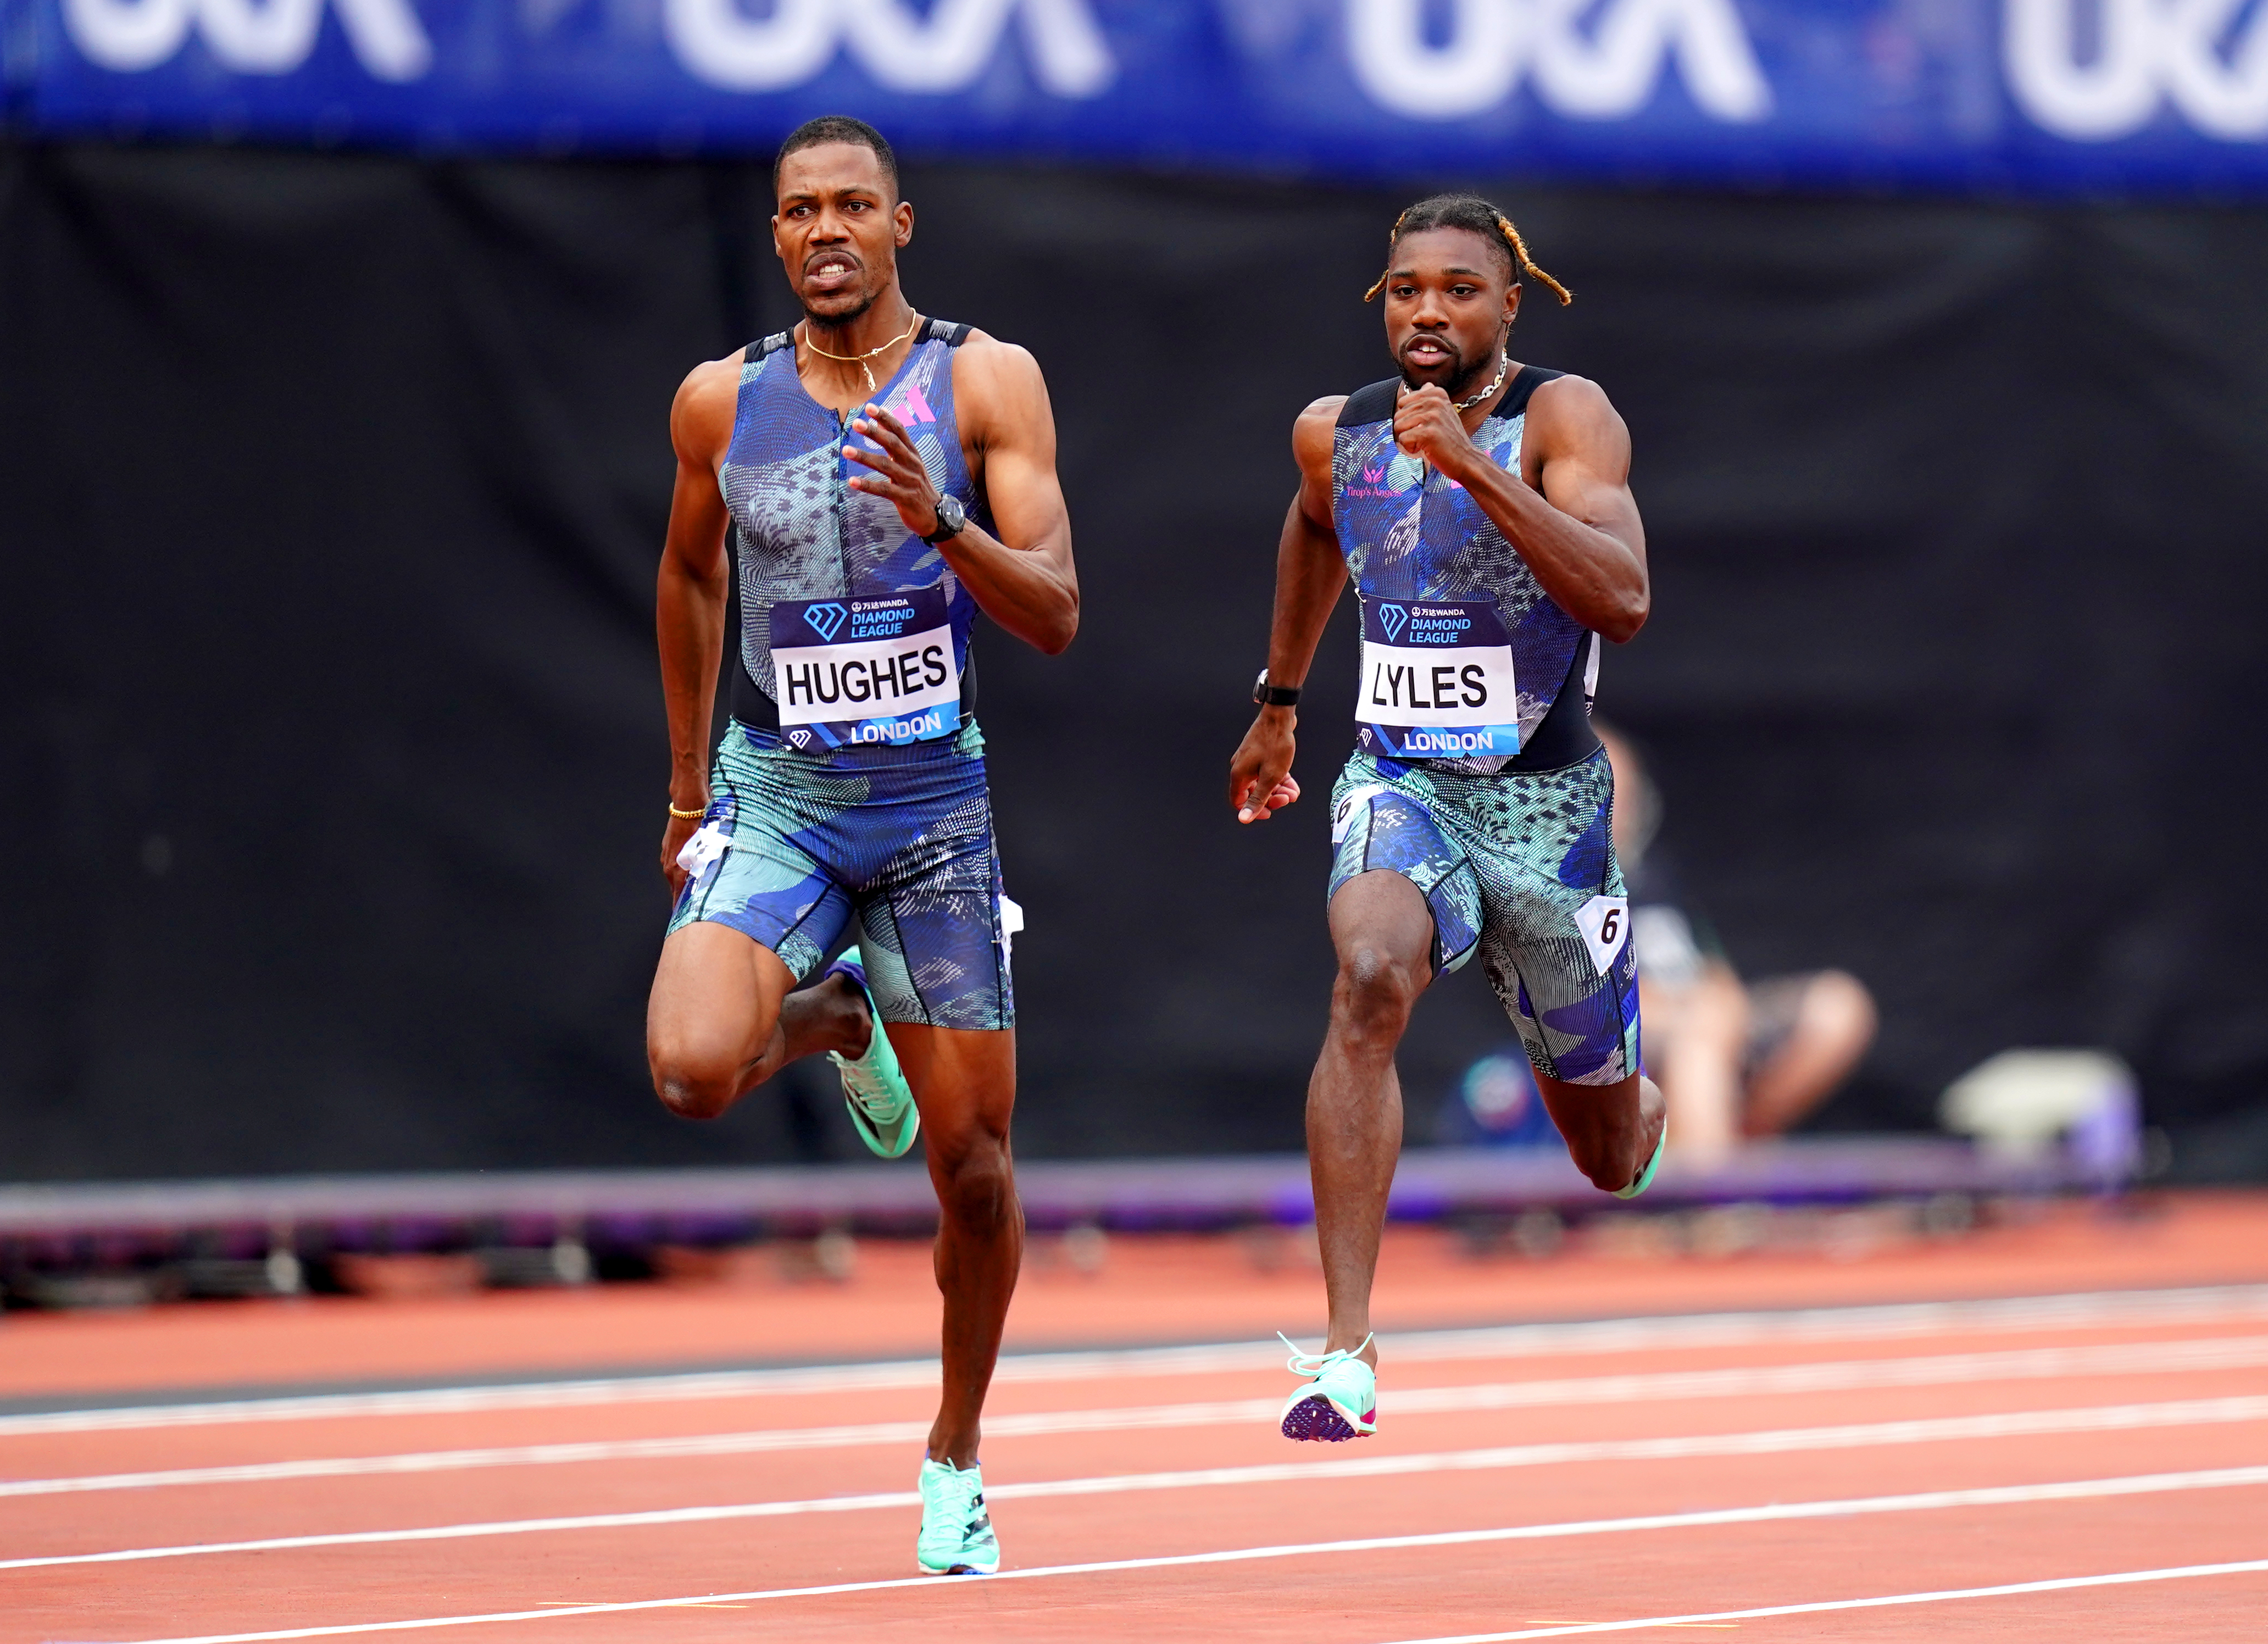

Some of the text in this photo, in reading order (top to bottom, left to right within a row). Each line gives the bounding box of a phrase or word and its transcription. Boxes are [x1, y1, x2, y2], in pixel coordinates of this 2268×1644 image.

[852, 608, 915, 625] DIAMOND
[1411, 618, 1471, 631] DIAMOND
[851, 622, 903, 638] LEAGUE
[1409, 631, 1459, 643] LEAGUE
[786, 645, 947, 706] HUGHES
[1372, 662, 1487, 709] LYLES
[851, 712, 942, 744] LONDON
[1404, 732, 1493, 751] LONDON
[1601, 908, 1621, 945] 6
